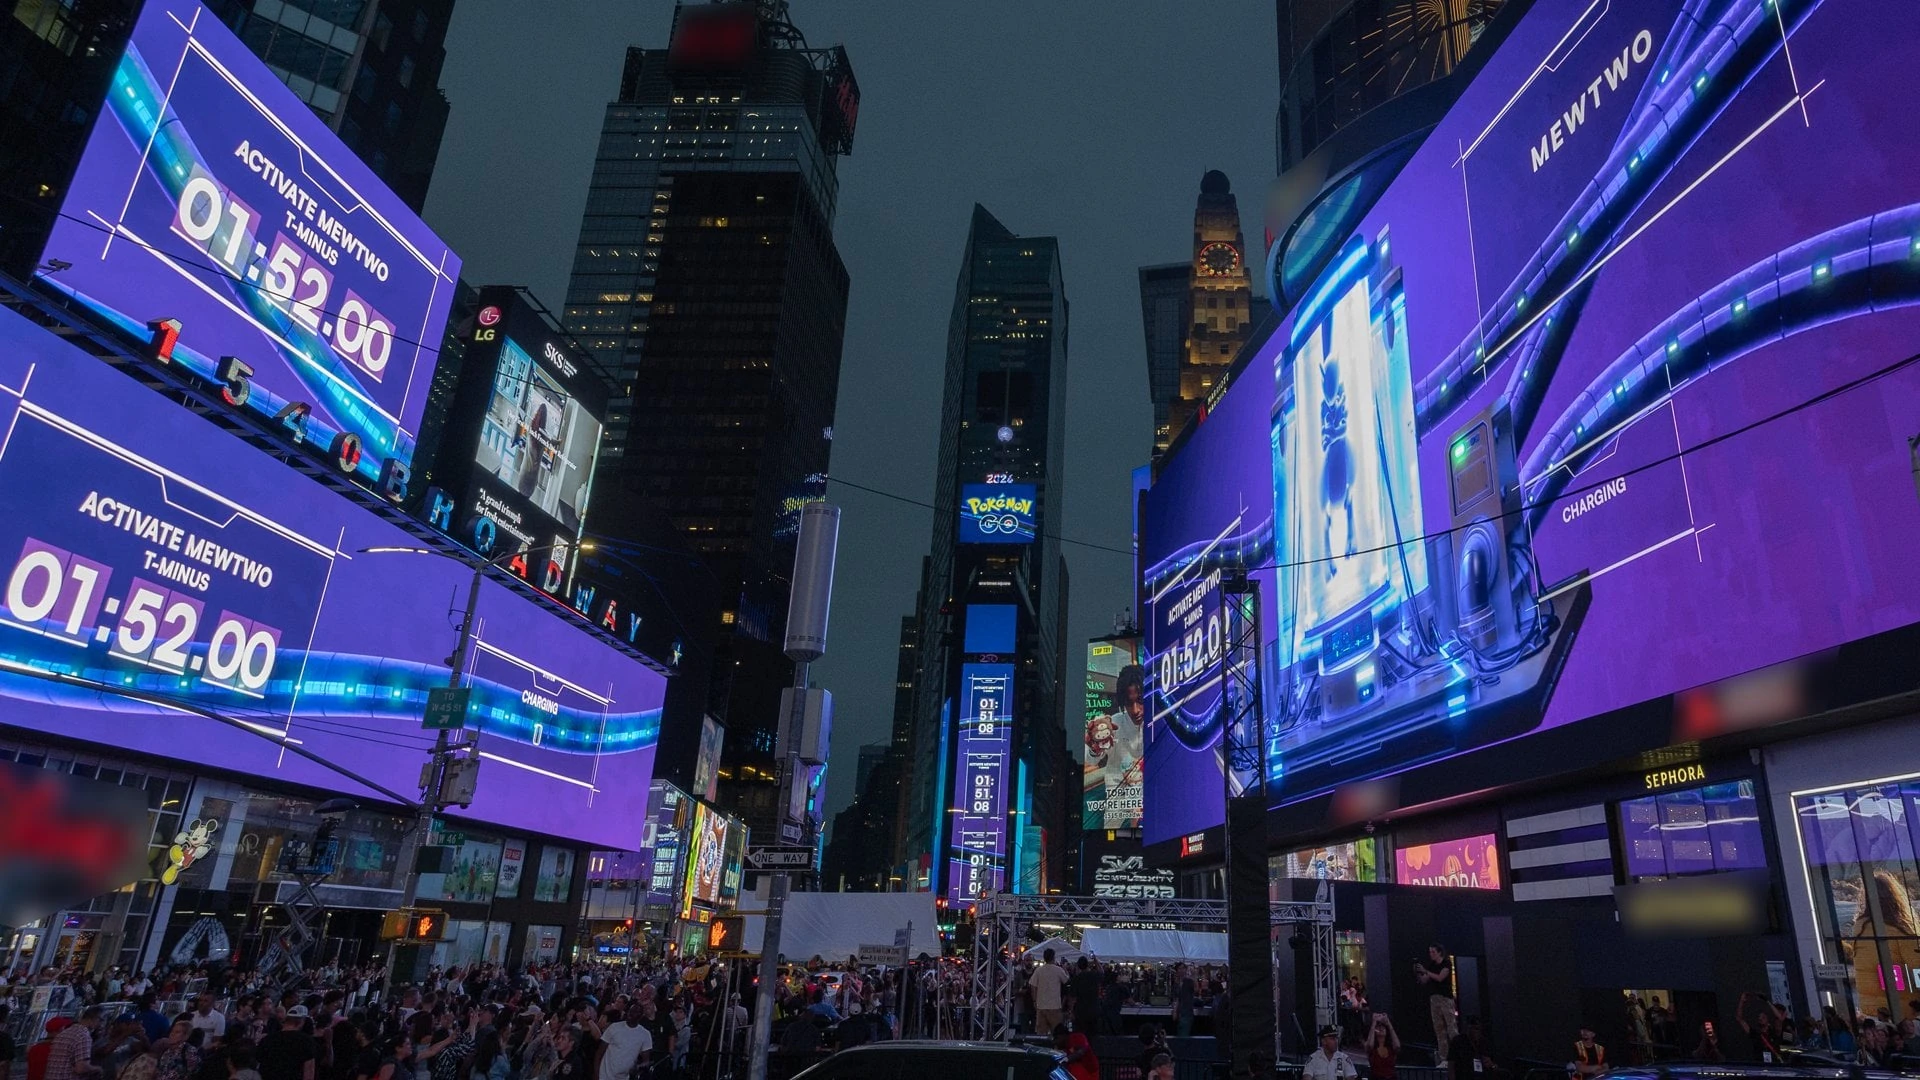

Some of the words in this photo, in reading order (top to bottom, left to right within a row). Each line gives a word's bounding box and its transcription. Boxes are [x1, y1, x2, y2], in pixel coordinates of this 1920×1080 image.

[1530, 29, 1652, 173] MEWTWO
[234, 139, 318, 222] ACTIVATE
[317, 201, 389, 282] MEWTWO
[284, 209, 339, 266] T-MINUS
[178, 177, 393, 372] 01:52.00
[474, 329, 496, 341] LG
[545, 342, 564, 369] SKS
[986, 473, 1014, 484] 2026
[1562, 476, 1628, 524] CHARGING
[979, 514, 1019, 534] GO
[79, 491, 185, 551] ACTIVATE
[184, 533, 273, 588] MEWTWO
[143, 550, 210, 592] T-MINUS
[1168, 594, 1193, 626] ACTIVATE
[1192, 567, 1222, 601] MEWTWO
[8, 550, 276, 689] 01:52.00
[1184, 604, 1203, 629] T-MINUS
[432, 703, 440, 712] W
[443, 692, 455, 701] TO
[521, 689, 559, 716] CHARGING
[978, 724, 994, 733] 08
[975, 775, 995, 786] 01:
[1645, 764, 1705, 789] SEPHORA
[974, 788, 994, 799] 51.
[1125, 787, 1142, 798] TOY
[973, 801, 990, 812] 08
[1119, 799, 1143, 809] HERE
[754, 852, 774, 864] ONE
[782, 852, 806, 864] WAY
[1095, 874, 1175, 883] COMPLEXITY
